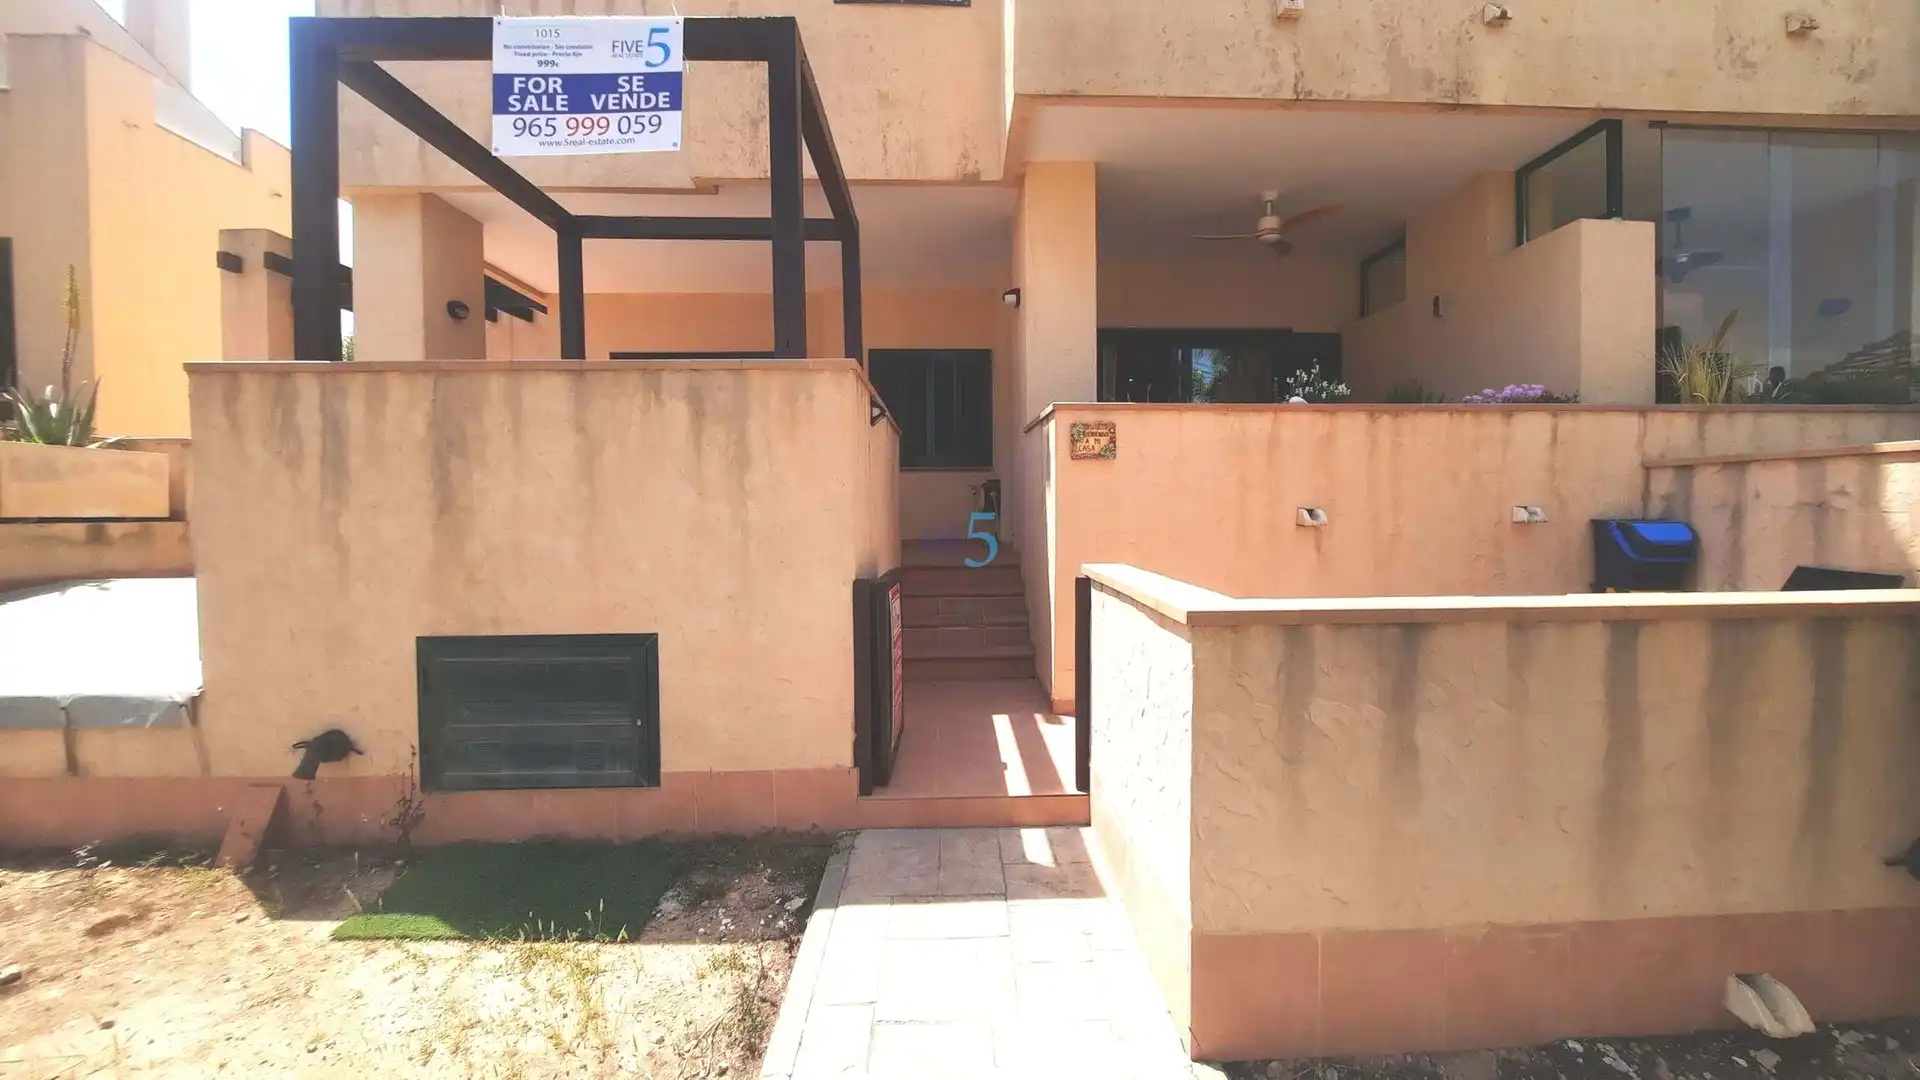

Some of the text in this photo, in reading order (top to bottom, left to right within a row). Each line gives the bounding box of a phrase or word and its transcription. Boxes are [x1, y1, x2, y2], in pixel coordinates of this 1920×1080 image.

[535, 28, 560, 38] 1015
[612, 40, 643, 53] FIVE
[644, 28, 671, 68] 5
[513, 77, 563, 94] FOR
[617, 75, 645, 92] SE
[508, 94, 569, 112] SALE
[590, 92, 671, 111] VENDE
[512, 114, 662, 138] 965 999 059
[538, 136, 636, 148] www.5real-estate.com
